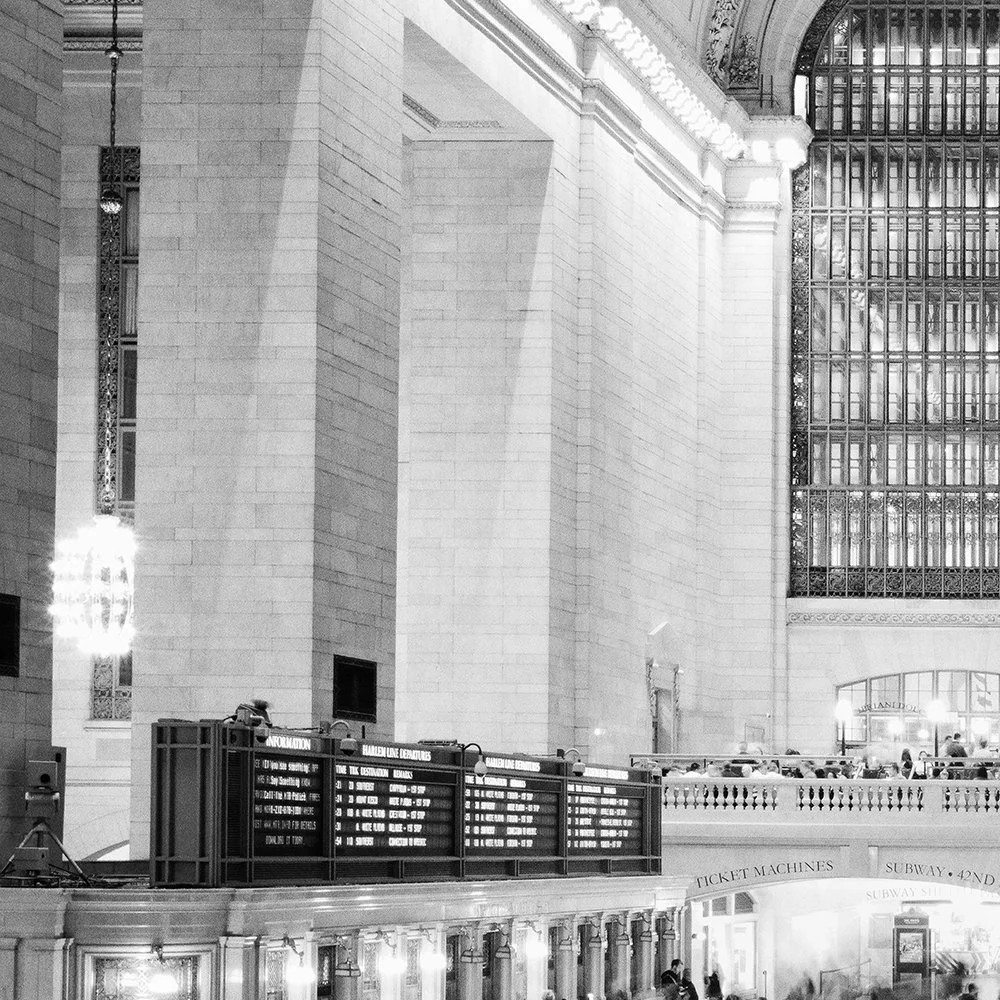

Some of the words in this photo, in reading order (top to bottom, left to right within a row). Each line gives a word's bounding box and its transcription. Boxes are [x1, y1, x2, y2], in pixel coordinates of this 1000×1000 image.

[362, 744, 386, 758] HARLEM
[386, 747, 399, 758] LINE
[400, 748, 432, 762] DEPARTURES
[696, 868, 749, 888] TICKET
[754, 860, 834, 878] MACHINES
[886, 862, 946, 878] SUBWAY
[957, 869, 996, 886] 42ND
[866, 887, 917, 900] SUBWAY
